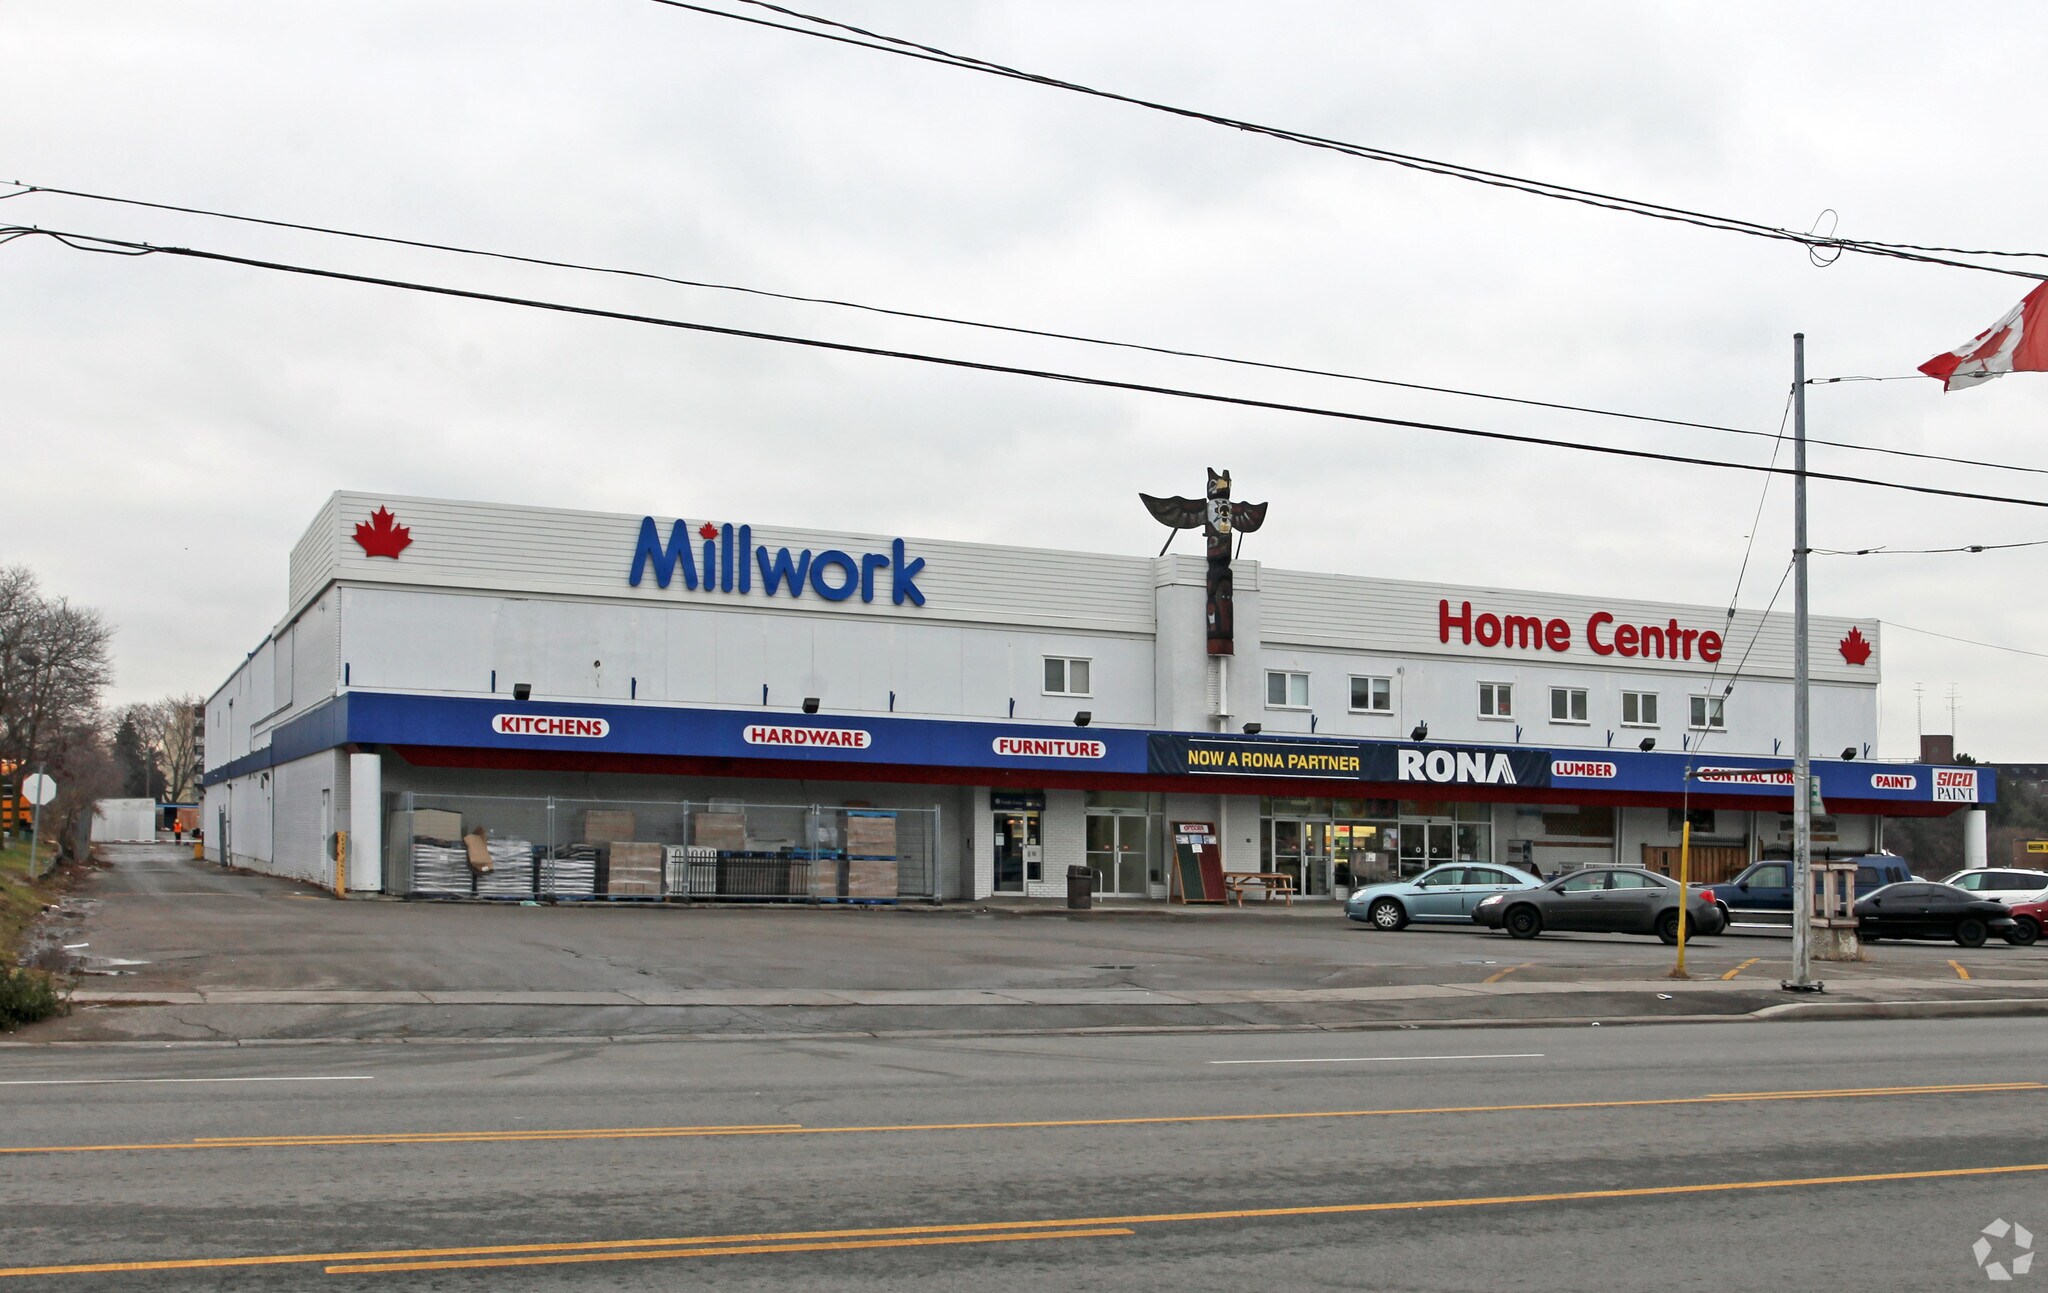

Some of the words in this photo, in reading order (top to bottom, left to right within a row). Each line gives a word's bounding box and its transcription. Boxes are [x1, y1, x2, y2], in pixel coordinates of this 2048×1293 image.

[629, 516, 926, 607] Millwork
[1439, 599, 1572, 653] Home
[1586, 611, 1723, 663] Centre
[501, 716, 603, 736] KITCHENS
[751, 728, 863, 747] HARDWARE
[999, 739, 1099, 757] FURNITURE
[1188, 750, 1225, 766] NOW
[1227, 753, 1239, 767] A
[1241, 752, 1284, 769] RONA
[1287, 754, 1361, 772] PARTNER
[1397, 749, 1518, 785] RONA
[1556, 763, 1612, 777] LUMBER
[1876, 776, 1912, 789] PAINT
[1936, 771, 1974, 788] SICO
[1937, 786, 1975, 801] PAINT
